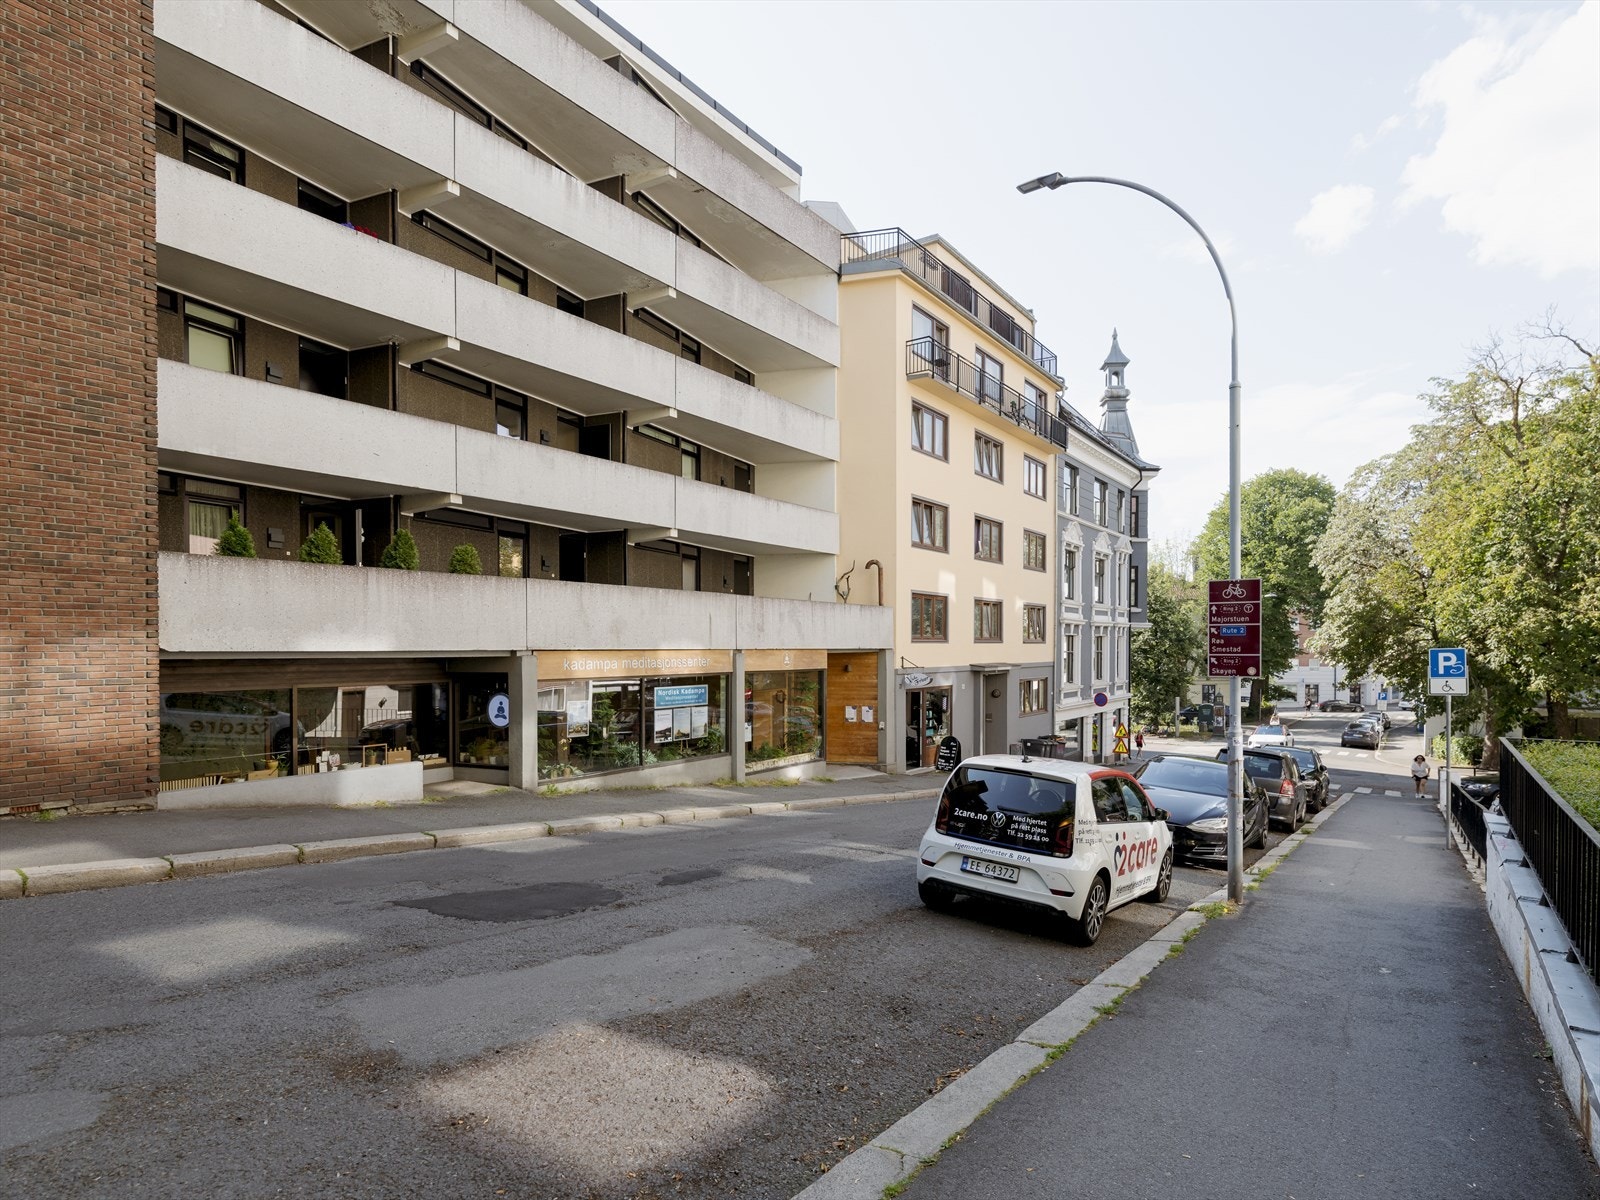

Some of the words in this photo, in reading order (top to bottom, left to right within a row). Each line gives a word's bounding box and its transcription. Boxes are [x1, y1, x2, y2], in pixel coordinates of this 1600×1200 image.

[1211, 616, 1250, 624] Majorstuen
[563, 657, 618, 672] kadampa
[621, 656, 711, 670] meditasjonssenter
[1438, 652, 1457, 675] P
[1211, 667, 1237, 675] Skøyen
[657, 688, 680, 696] Nordisk
[681, 687, 705, 695] Kadampa
[954, 807, 988, 821] 2care.no
[1012, 815, 1026, 823] Med
[1026, 817, 1047, 826] hjertet
[1031, 826, 1047, 834] plass
[1024, 833, 1033, 841] 59
[954, 842, 1008, 858] Hjemmetjenester
[1016, 854, 1031, 863] BPA
[1116, 837, 1158, 877] 2care
[969, 860, 982, 872] EE
[984, 863, 1016, 879] 64372
